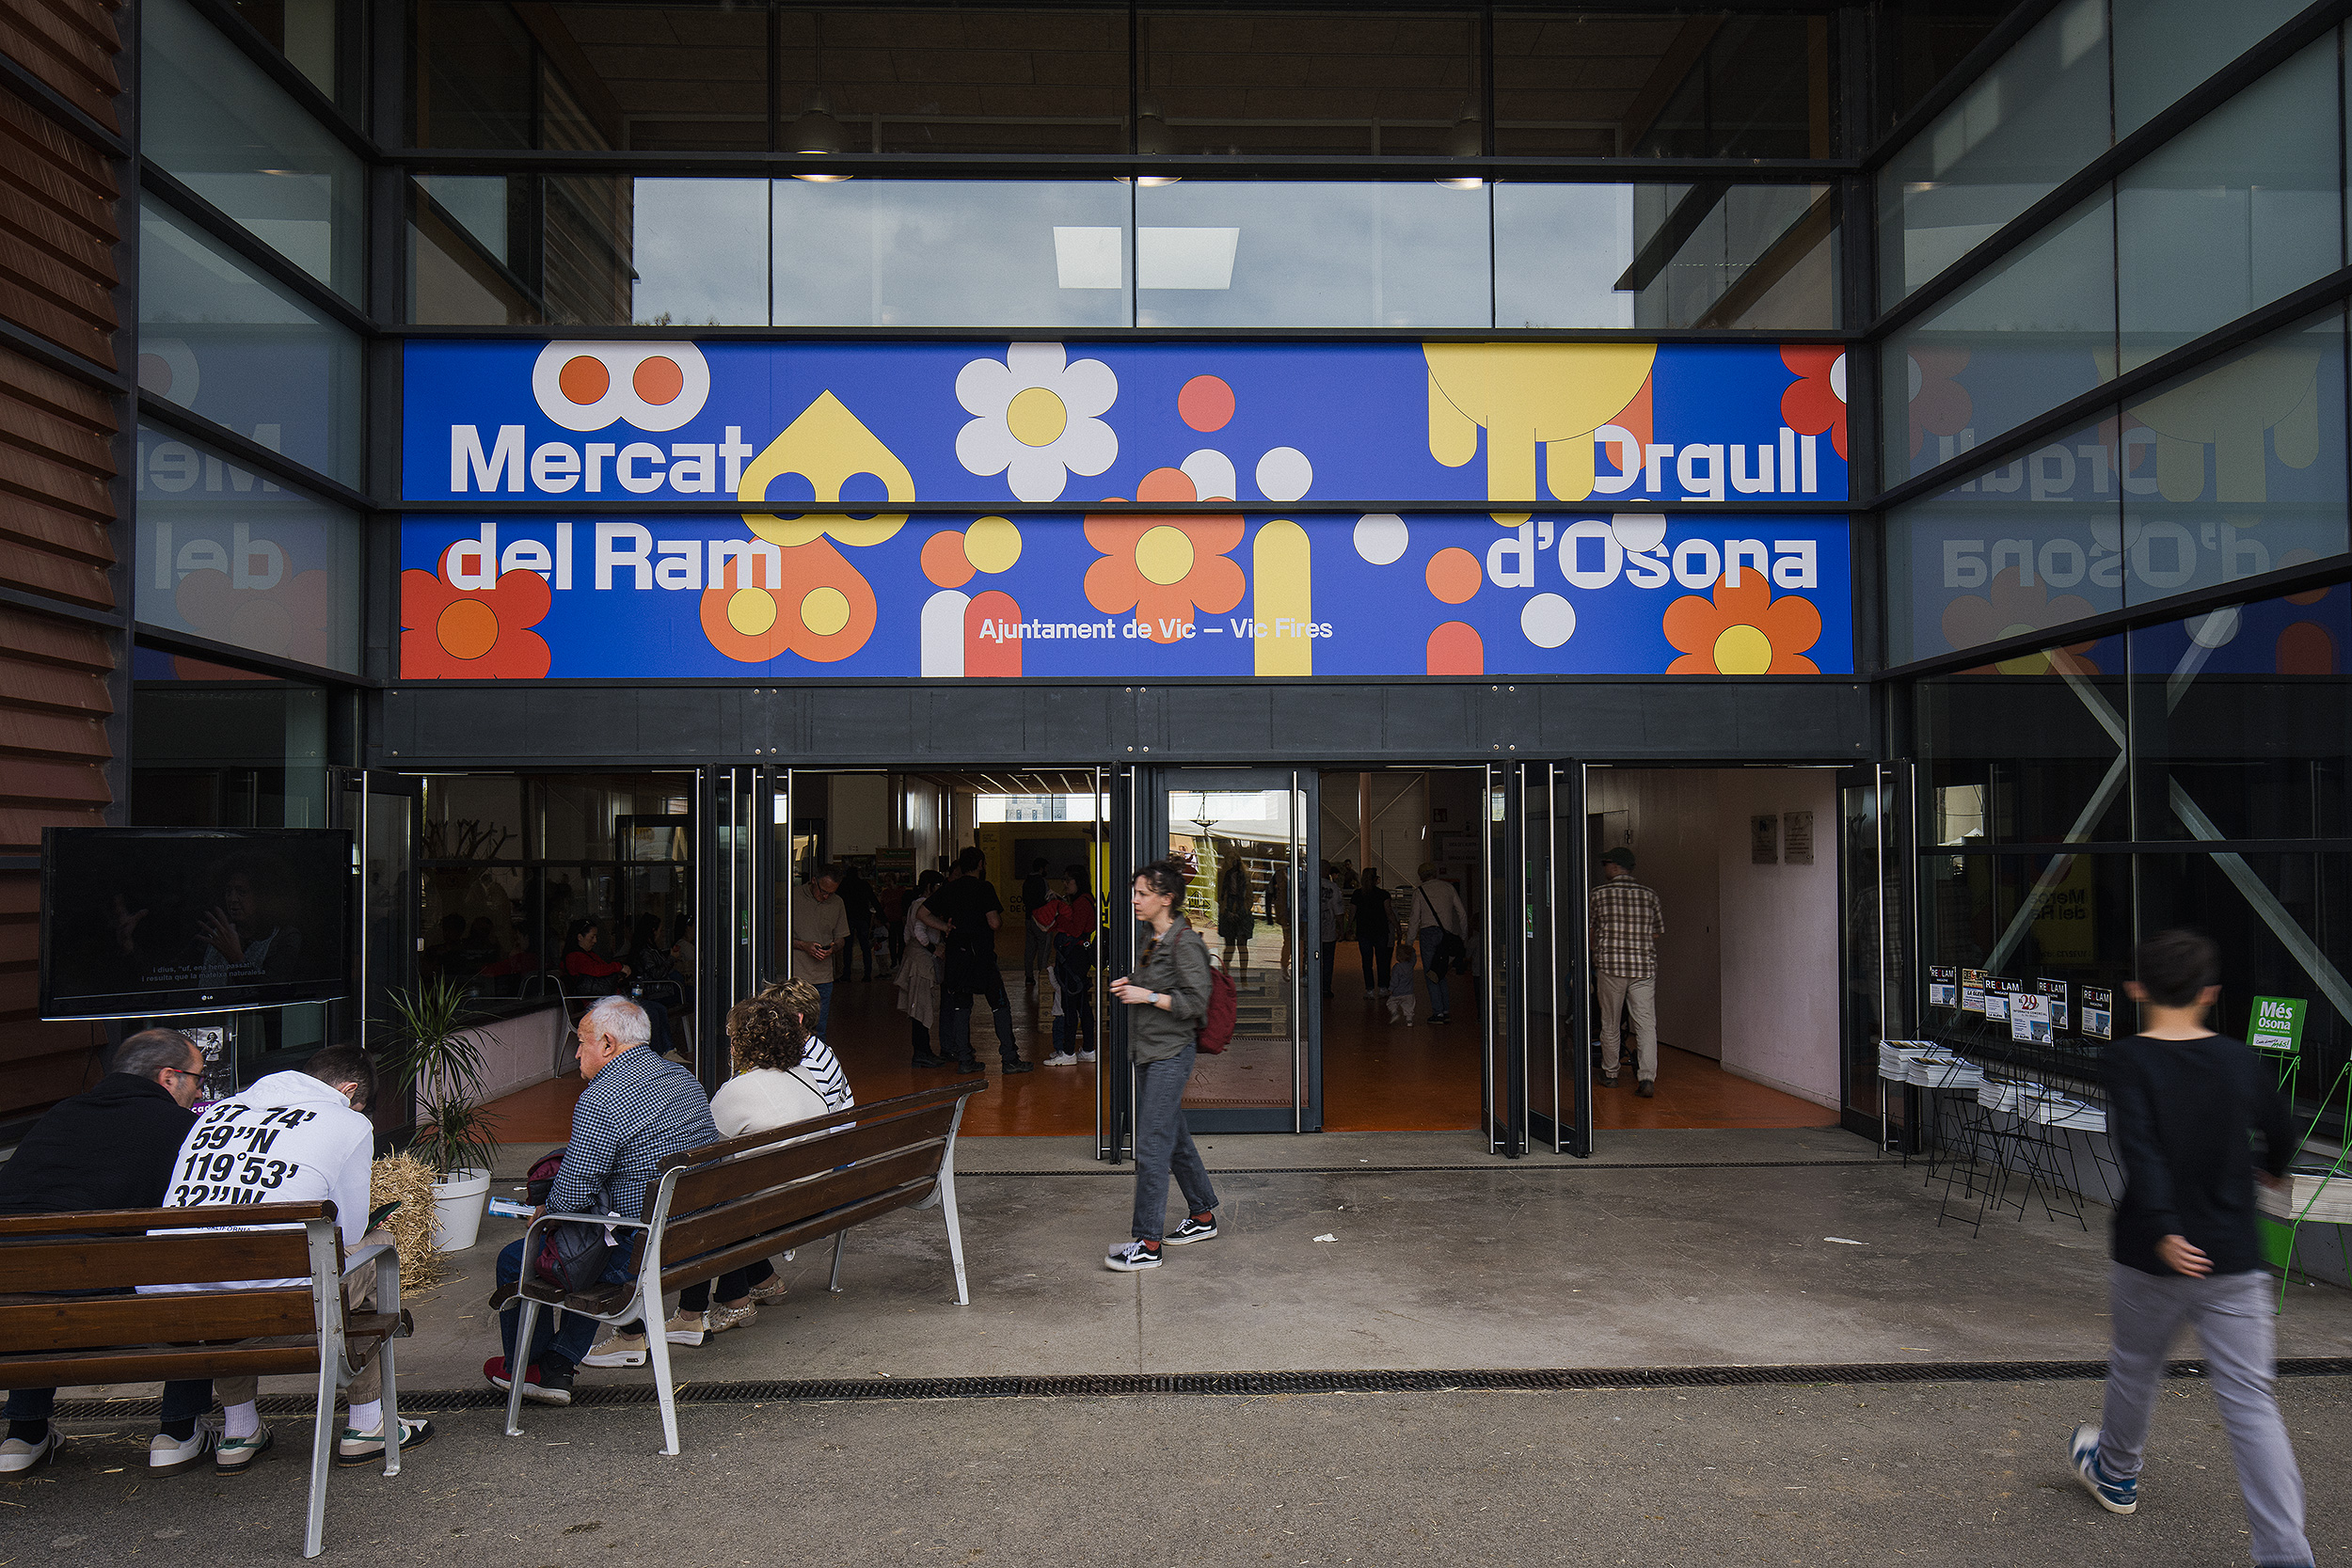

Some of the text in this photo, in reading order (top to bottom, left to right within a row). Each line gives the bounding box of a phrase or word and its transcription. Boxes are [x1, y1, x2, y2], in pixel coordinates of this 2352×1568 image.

[451, 424, 753, 493] Mercat
[446, 522, 782, 590] del Ram
[979, 617, 1116, 643] Ajuntament
[1122, 617, 1152, 639] de
[1158, 617, 1197, 639] Vic
[1231, 617, 1267, 639] Vic
[1276, 617, 1334, 639] Fires
[1931, 969, 1954, 977] RECLAM
[1985, 980, 2020, 992] RECLAM
[2039, 981, 2065, 993] RECLAM
[2083, 990, 2109, 1003] RECLAM
[2260, 1001, 2294, 1020] Més
[2258, 1017, 2291, 1030] Osona
